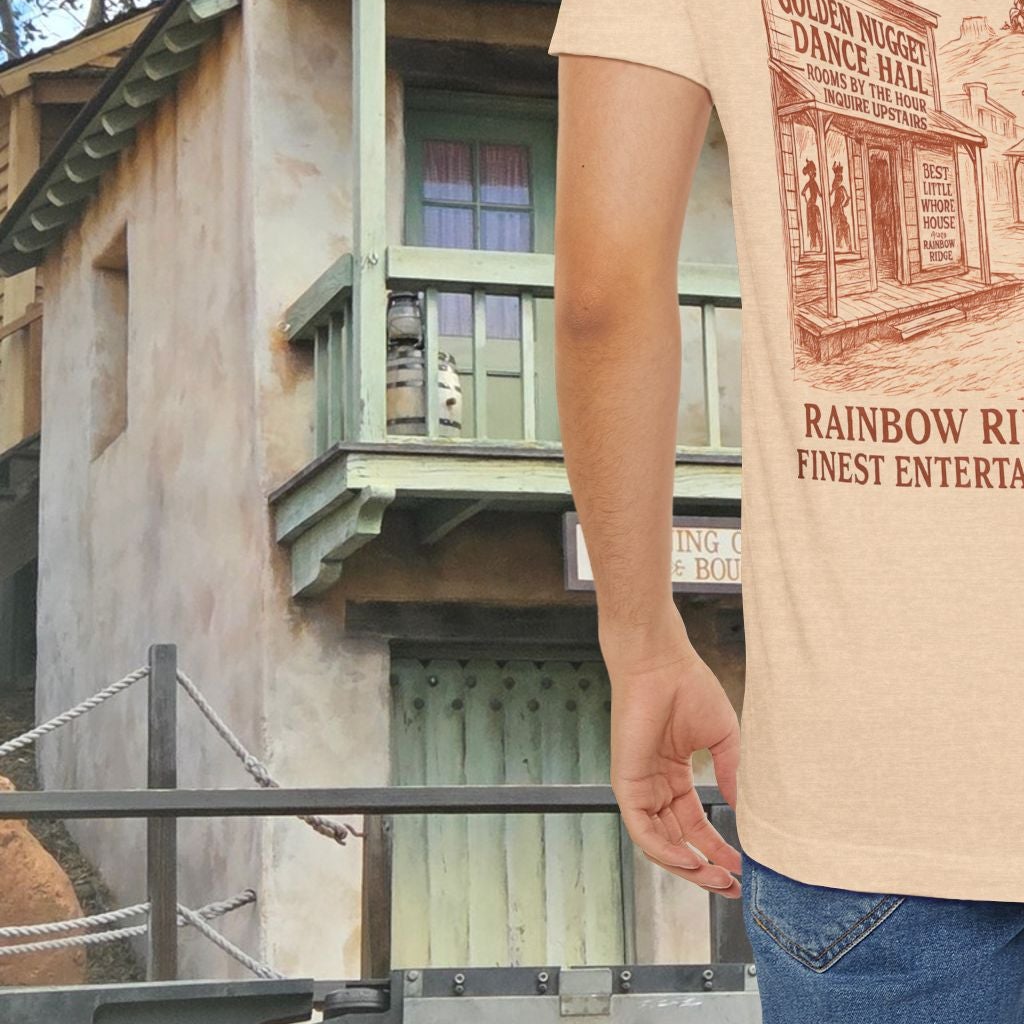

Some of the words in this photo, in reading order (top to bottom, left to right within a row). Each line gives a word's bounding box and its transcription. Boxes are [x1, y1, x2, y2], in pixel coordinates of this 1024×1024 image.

[856, 10, 927, 67] NUGGET
[791, 19, 869, 76] DANCE
[876, 53, 929, 95] HALL
[806, 63, 848, 90] ROOMS
[850, 76, 866, 95] BY
[869, 83, 893, 103] THE
[895, 91, 928, 113] HOUR
[823, 88, 870, 114] INQUIRE
[872, 102, 928, 130] UPSTAIRS
[922, 163, 949, 180] BEST
[923, 182, 953, 197] LITTLE
[921, 199, 956, 213] WHORE
[923, 216, 956, 229] HOUSE
[923, 239, 956, 250] RAINBOW
[929, 251, 954, 262] RIDGE
[804, 403, 968, 445] RAINBOW
[797, 448, 885, 485] FINEST
[671, 529, 720, 554] ING
